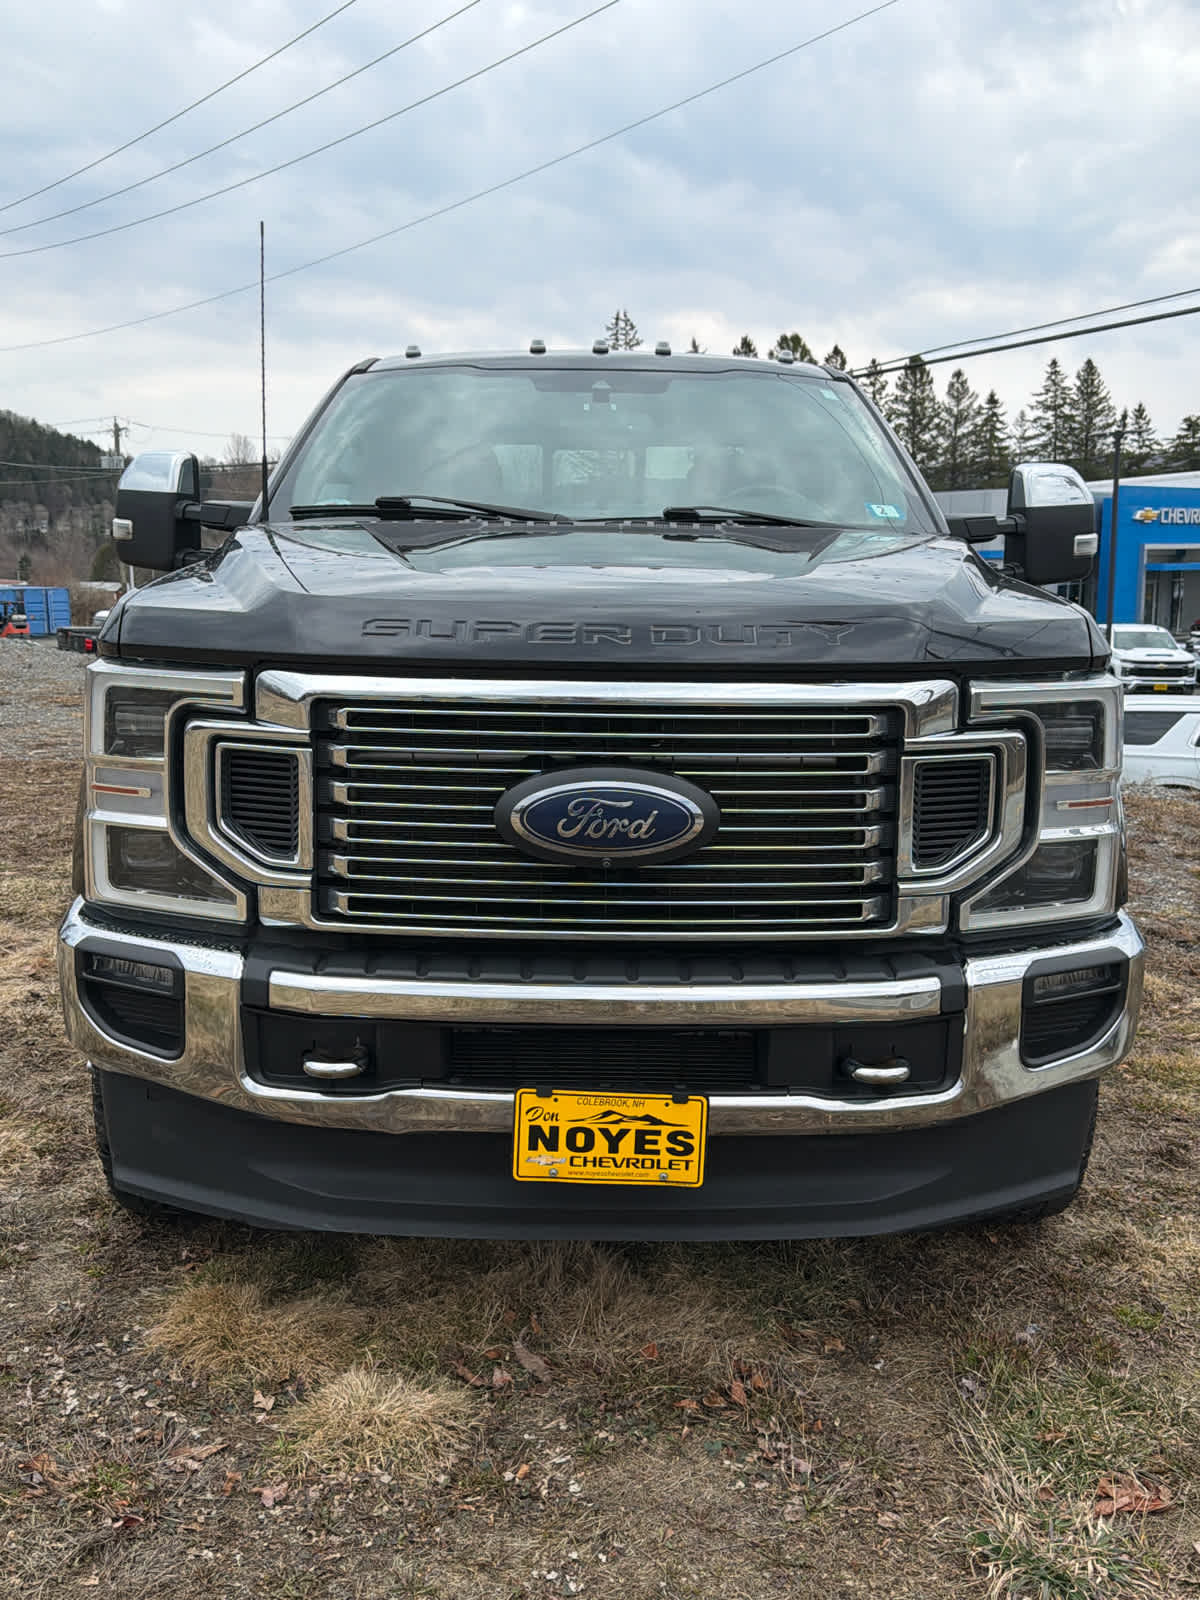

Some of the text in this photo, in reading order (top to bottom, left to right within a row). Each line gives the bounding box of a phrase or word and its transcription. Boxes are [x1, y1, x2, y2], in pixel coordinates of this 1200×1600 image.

[361, 618, 855, 646] SUPER DUTY
[556, 797, 659, 839] Ford
[525, 1106, 560, 1122] Don
[632, 1099, 646, 1109] NH
[527, 1124, 695, 1157] NOYES
[569, 1155, 694, 1171] CHEVROLET
